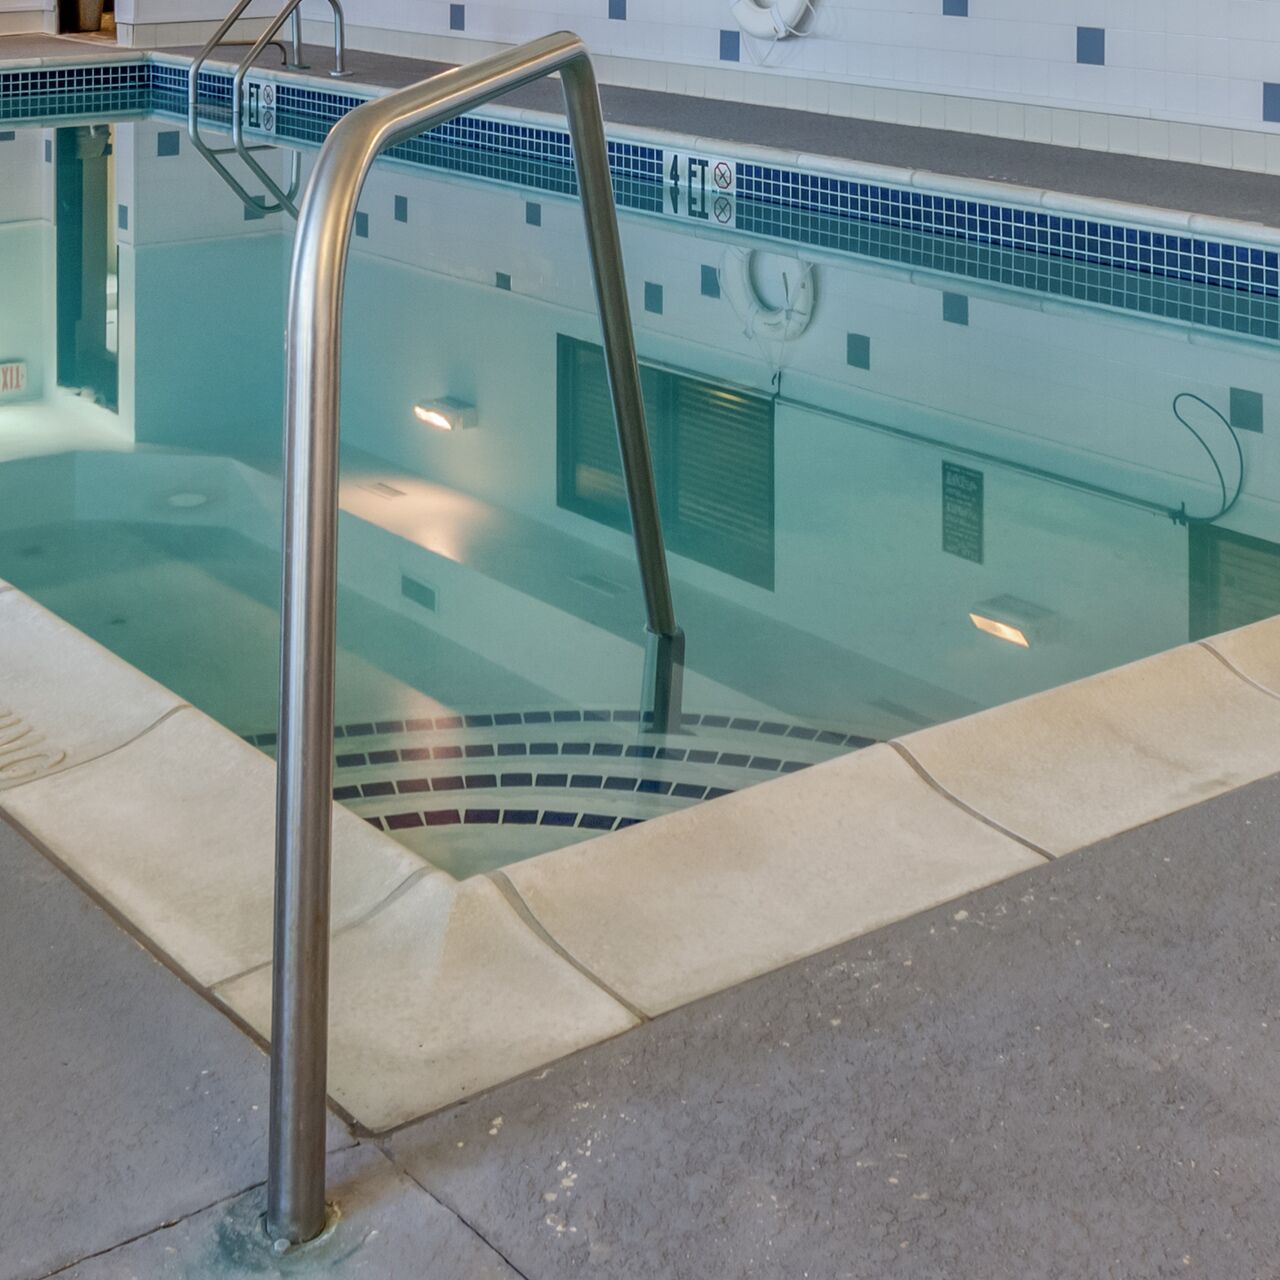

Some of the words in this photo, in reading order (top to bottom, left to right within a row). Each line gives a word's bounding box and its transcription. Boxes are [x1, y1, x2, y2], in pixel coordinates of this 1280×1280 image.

[249, 82, 261, 104] FT
[670, 154, 680, 186] 4
[688, 157, 709, 191] FT
